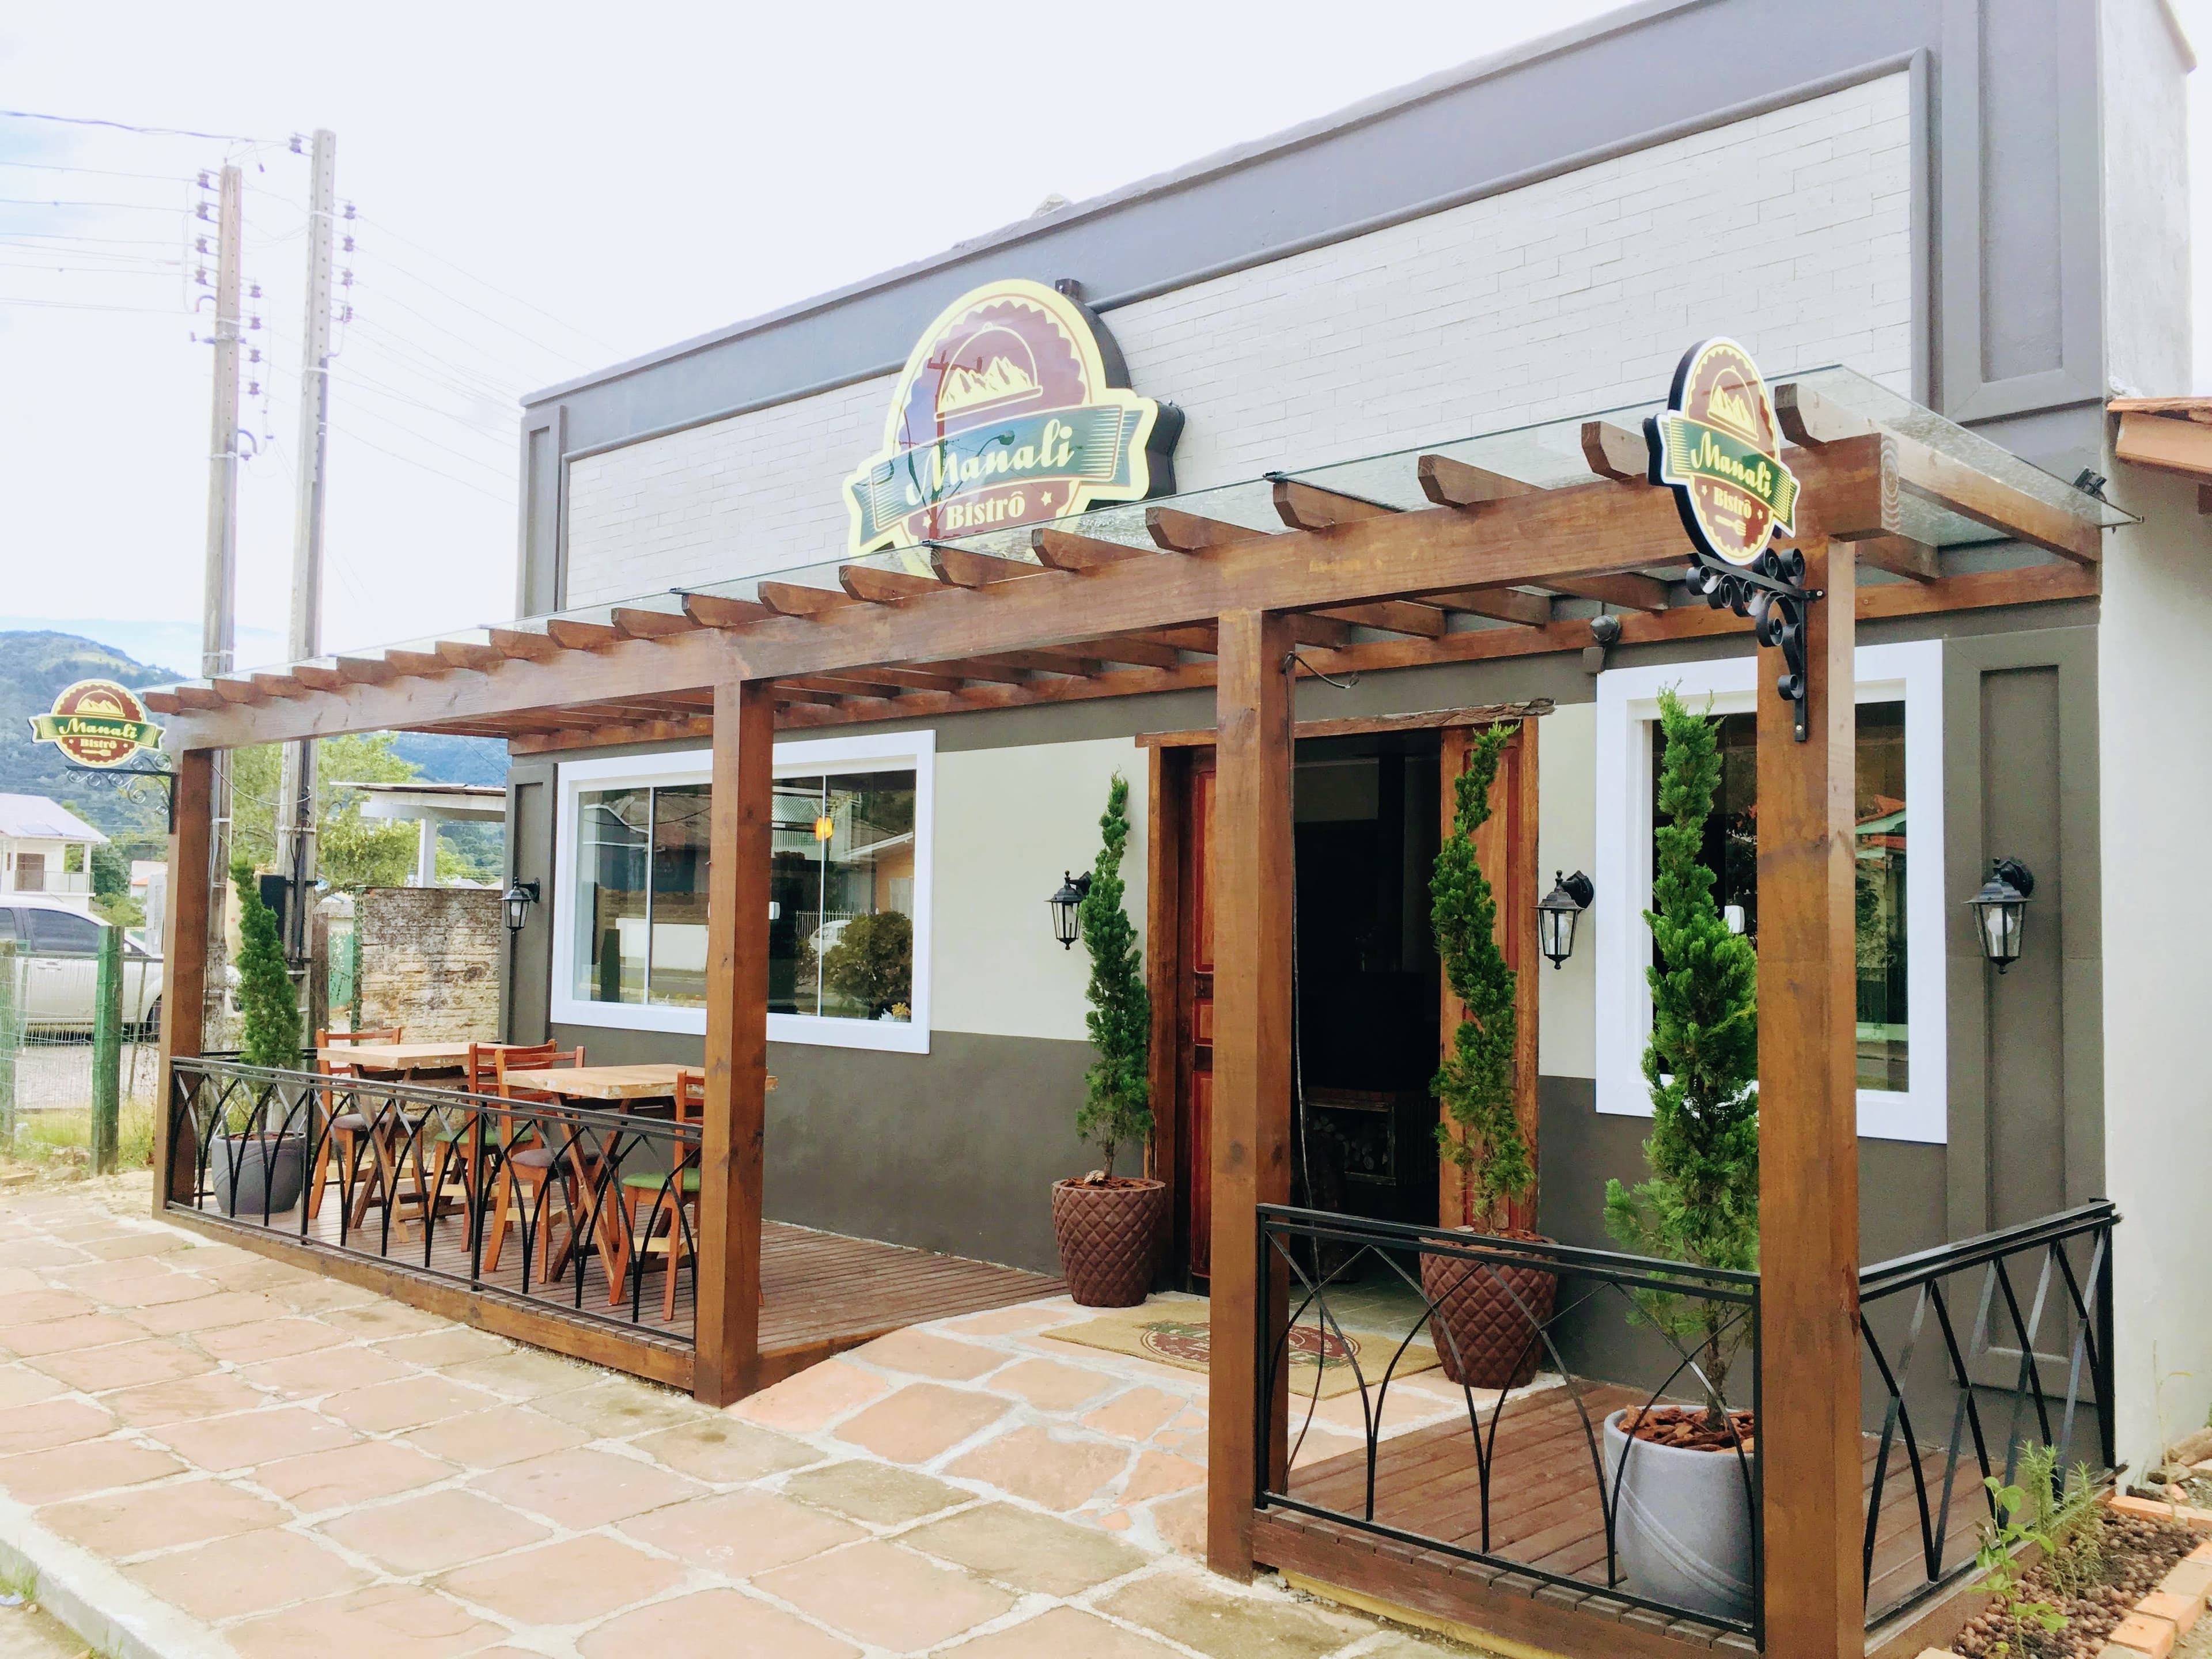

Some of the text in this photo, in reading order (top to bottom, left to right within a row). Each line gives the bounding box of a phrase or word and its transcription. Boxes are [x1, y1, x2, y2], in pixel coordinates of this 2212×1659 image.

[906, 419, 1075, 505] Manali
[1691, 431, 1772, 498] Manali
[945, 491, 1025, 530] Bistrô
[1713, 487, 1752, 518] Bistrô
[59, 718, 137, 738] Manali
[80, 738, 117, 749] Bistrô
